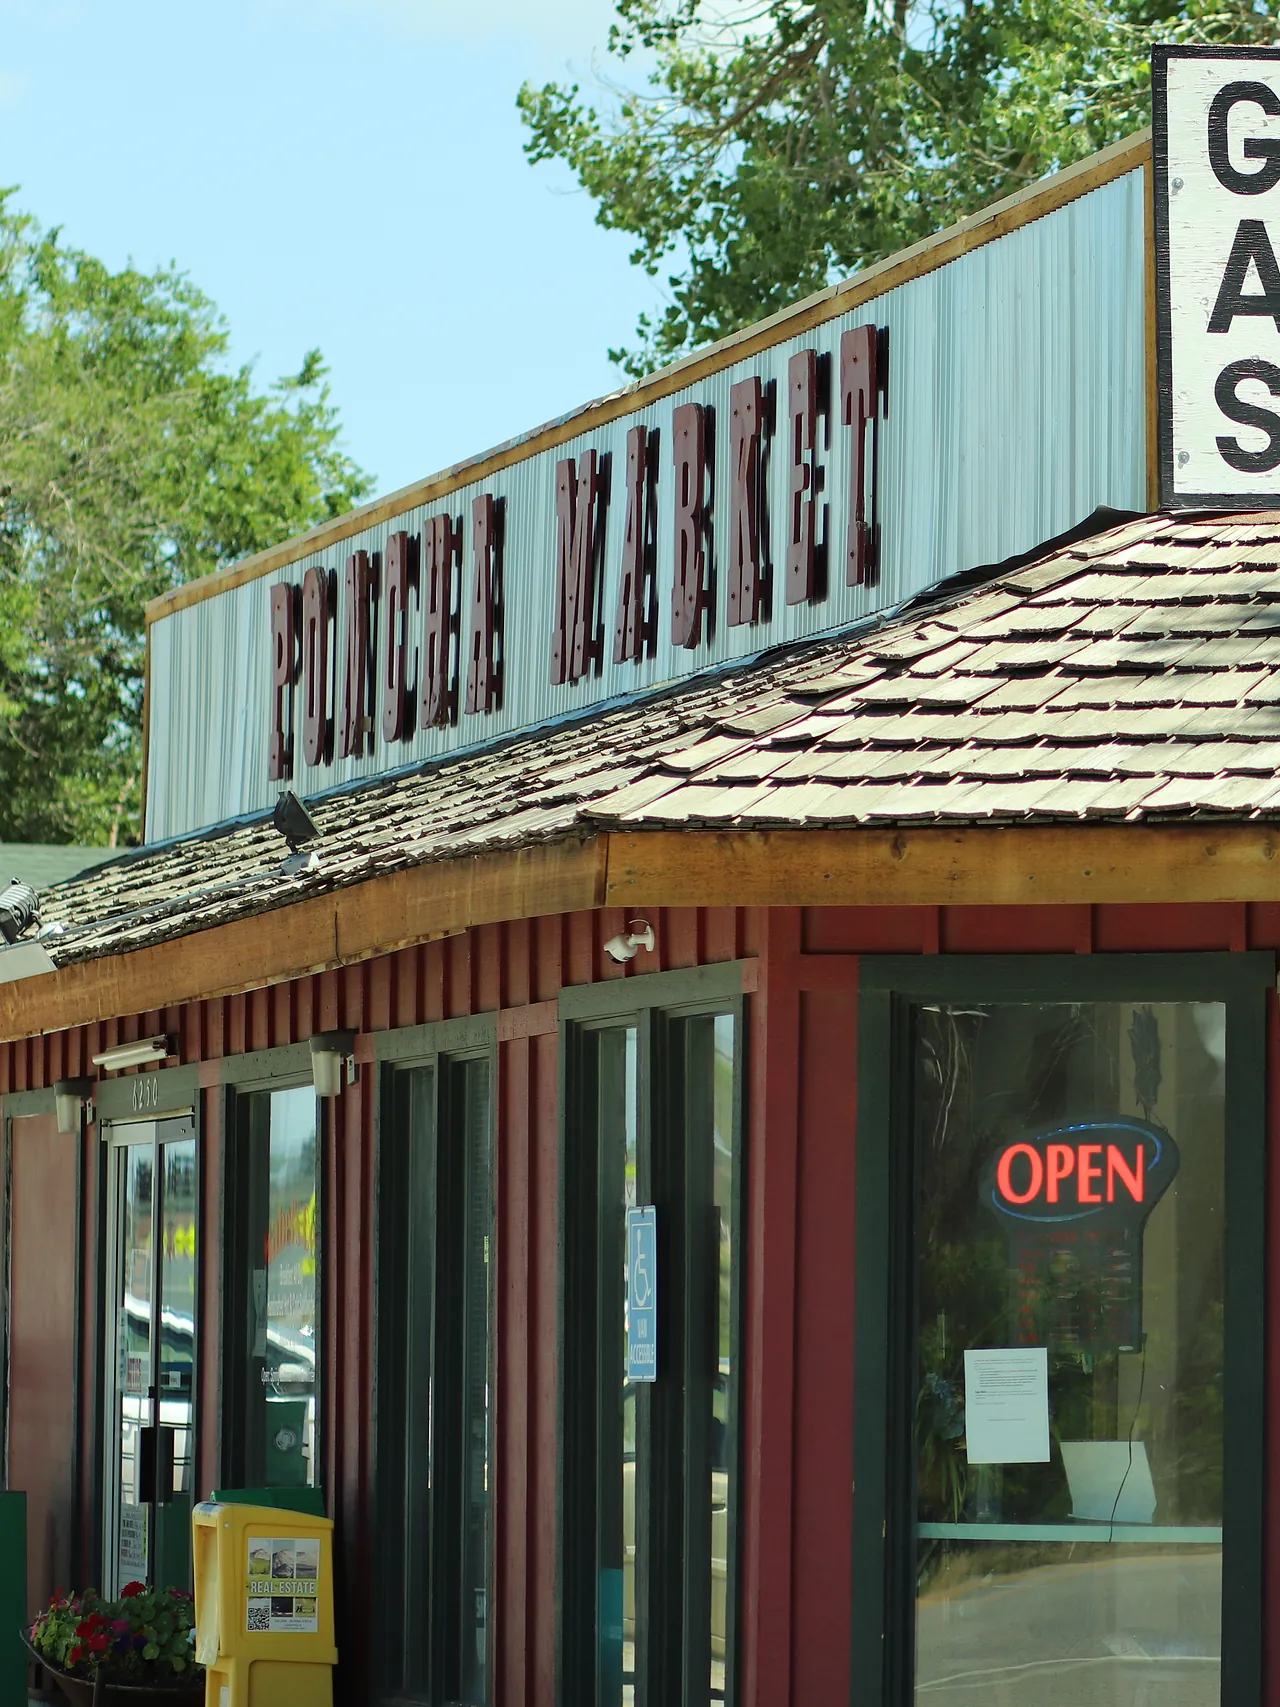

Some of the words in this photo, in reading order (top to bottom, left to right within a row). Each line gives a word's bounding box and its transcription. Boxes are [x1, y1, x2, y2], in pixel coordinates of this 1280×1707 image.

[268, 491, 495, 782] PONCHA
[549, 322, 879, 686] MARKET
[996, 1142, 1146, 1205] OPEN
[629, 1343, 655, 1365] ACCESSIBLE
[251, 1581, 276, 1594] REAL
[279, 1581, 315, 1595] ESTATE
